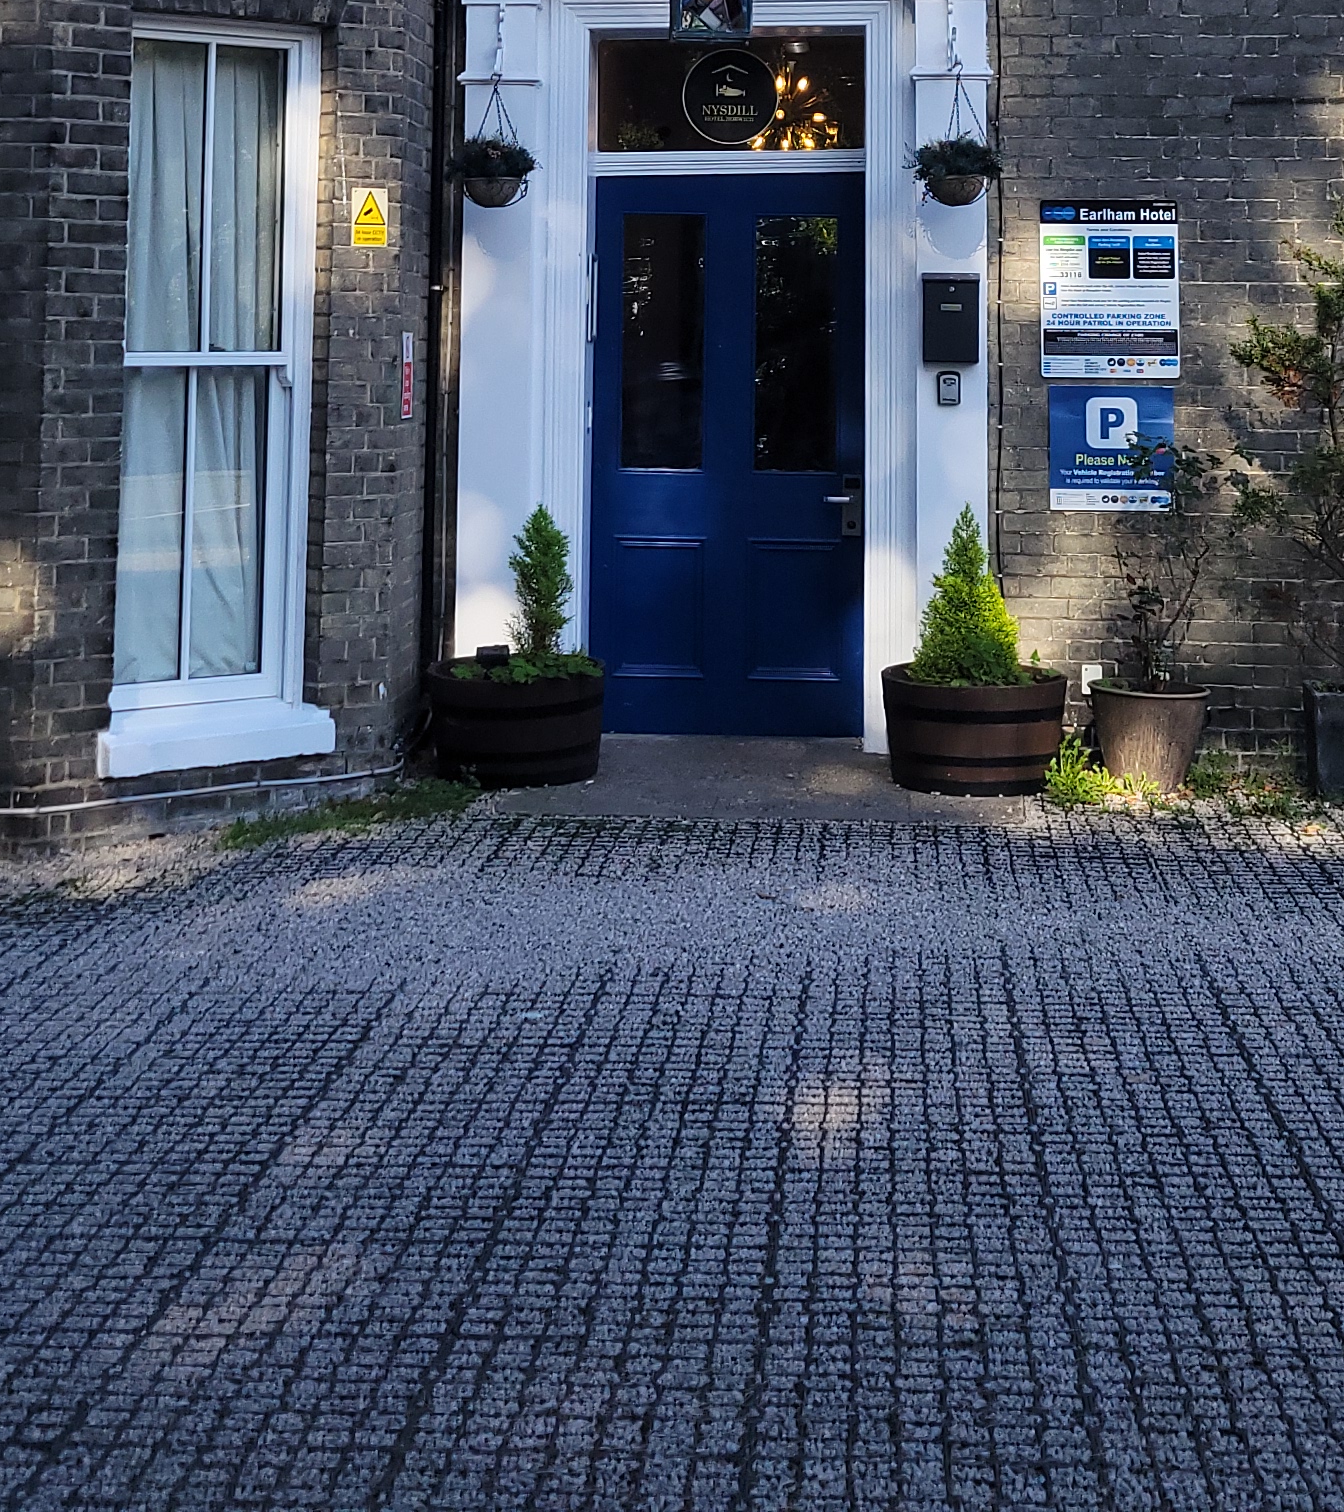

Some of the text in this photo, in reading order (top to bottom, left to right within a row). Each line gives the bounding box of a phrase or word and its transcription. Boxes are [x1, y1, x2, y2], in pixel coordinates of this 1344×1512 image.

[702, 104, 759, 116] NYSDILL
[1079, 208, 1176, 221] Earlham Hotel
[1099, 407, 1125, 440] P
[1076, 454, 1115, 466] Please
[1073, 468, 1097, 476] Vehicle
[1098, 468, 1140, 477] Registratio
